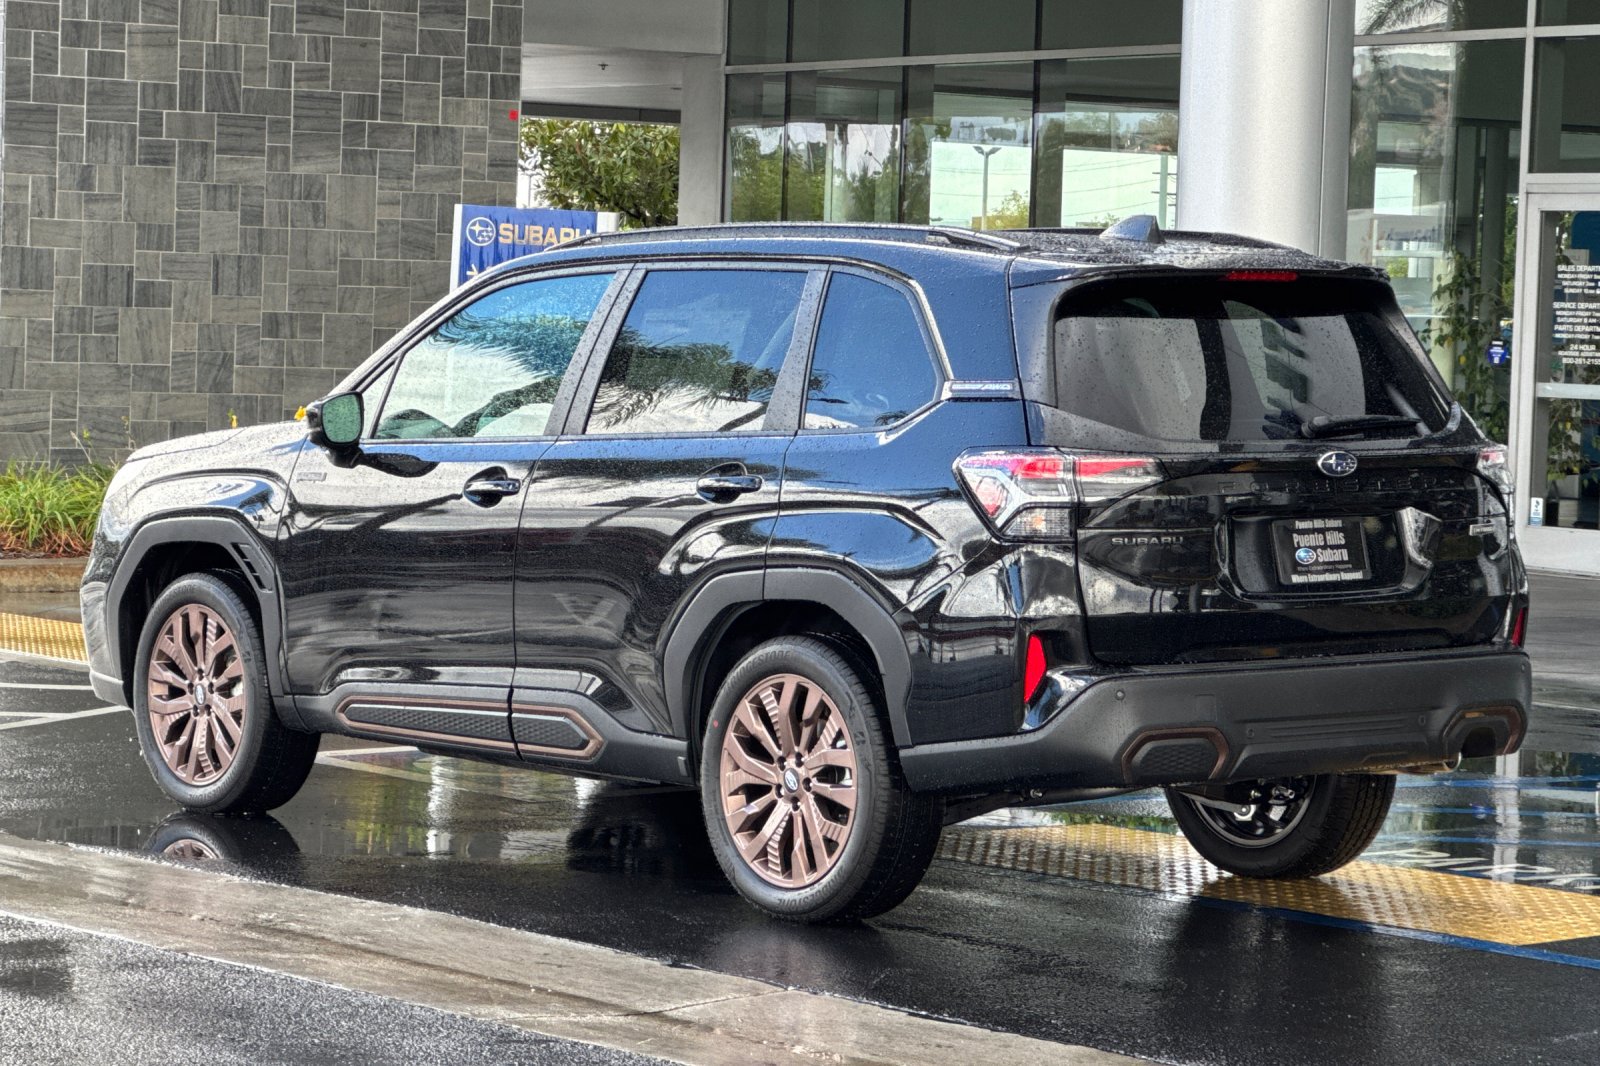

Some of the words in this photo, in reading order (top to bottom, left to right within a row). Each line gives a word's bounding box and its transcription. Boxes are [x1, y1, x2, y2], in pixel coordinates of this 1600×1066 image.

[1552, 301, 1577, 309] SERVICE
[1569, 343, 1579, 351] 24
[1112, 536, 1184, 545] SUBARU
[1292, 532, 1325, 548] Puente
[1325, 530, 1346, 546] Hills
[1317, 547, 1349, 563] Subaru
